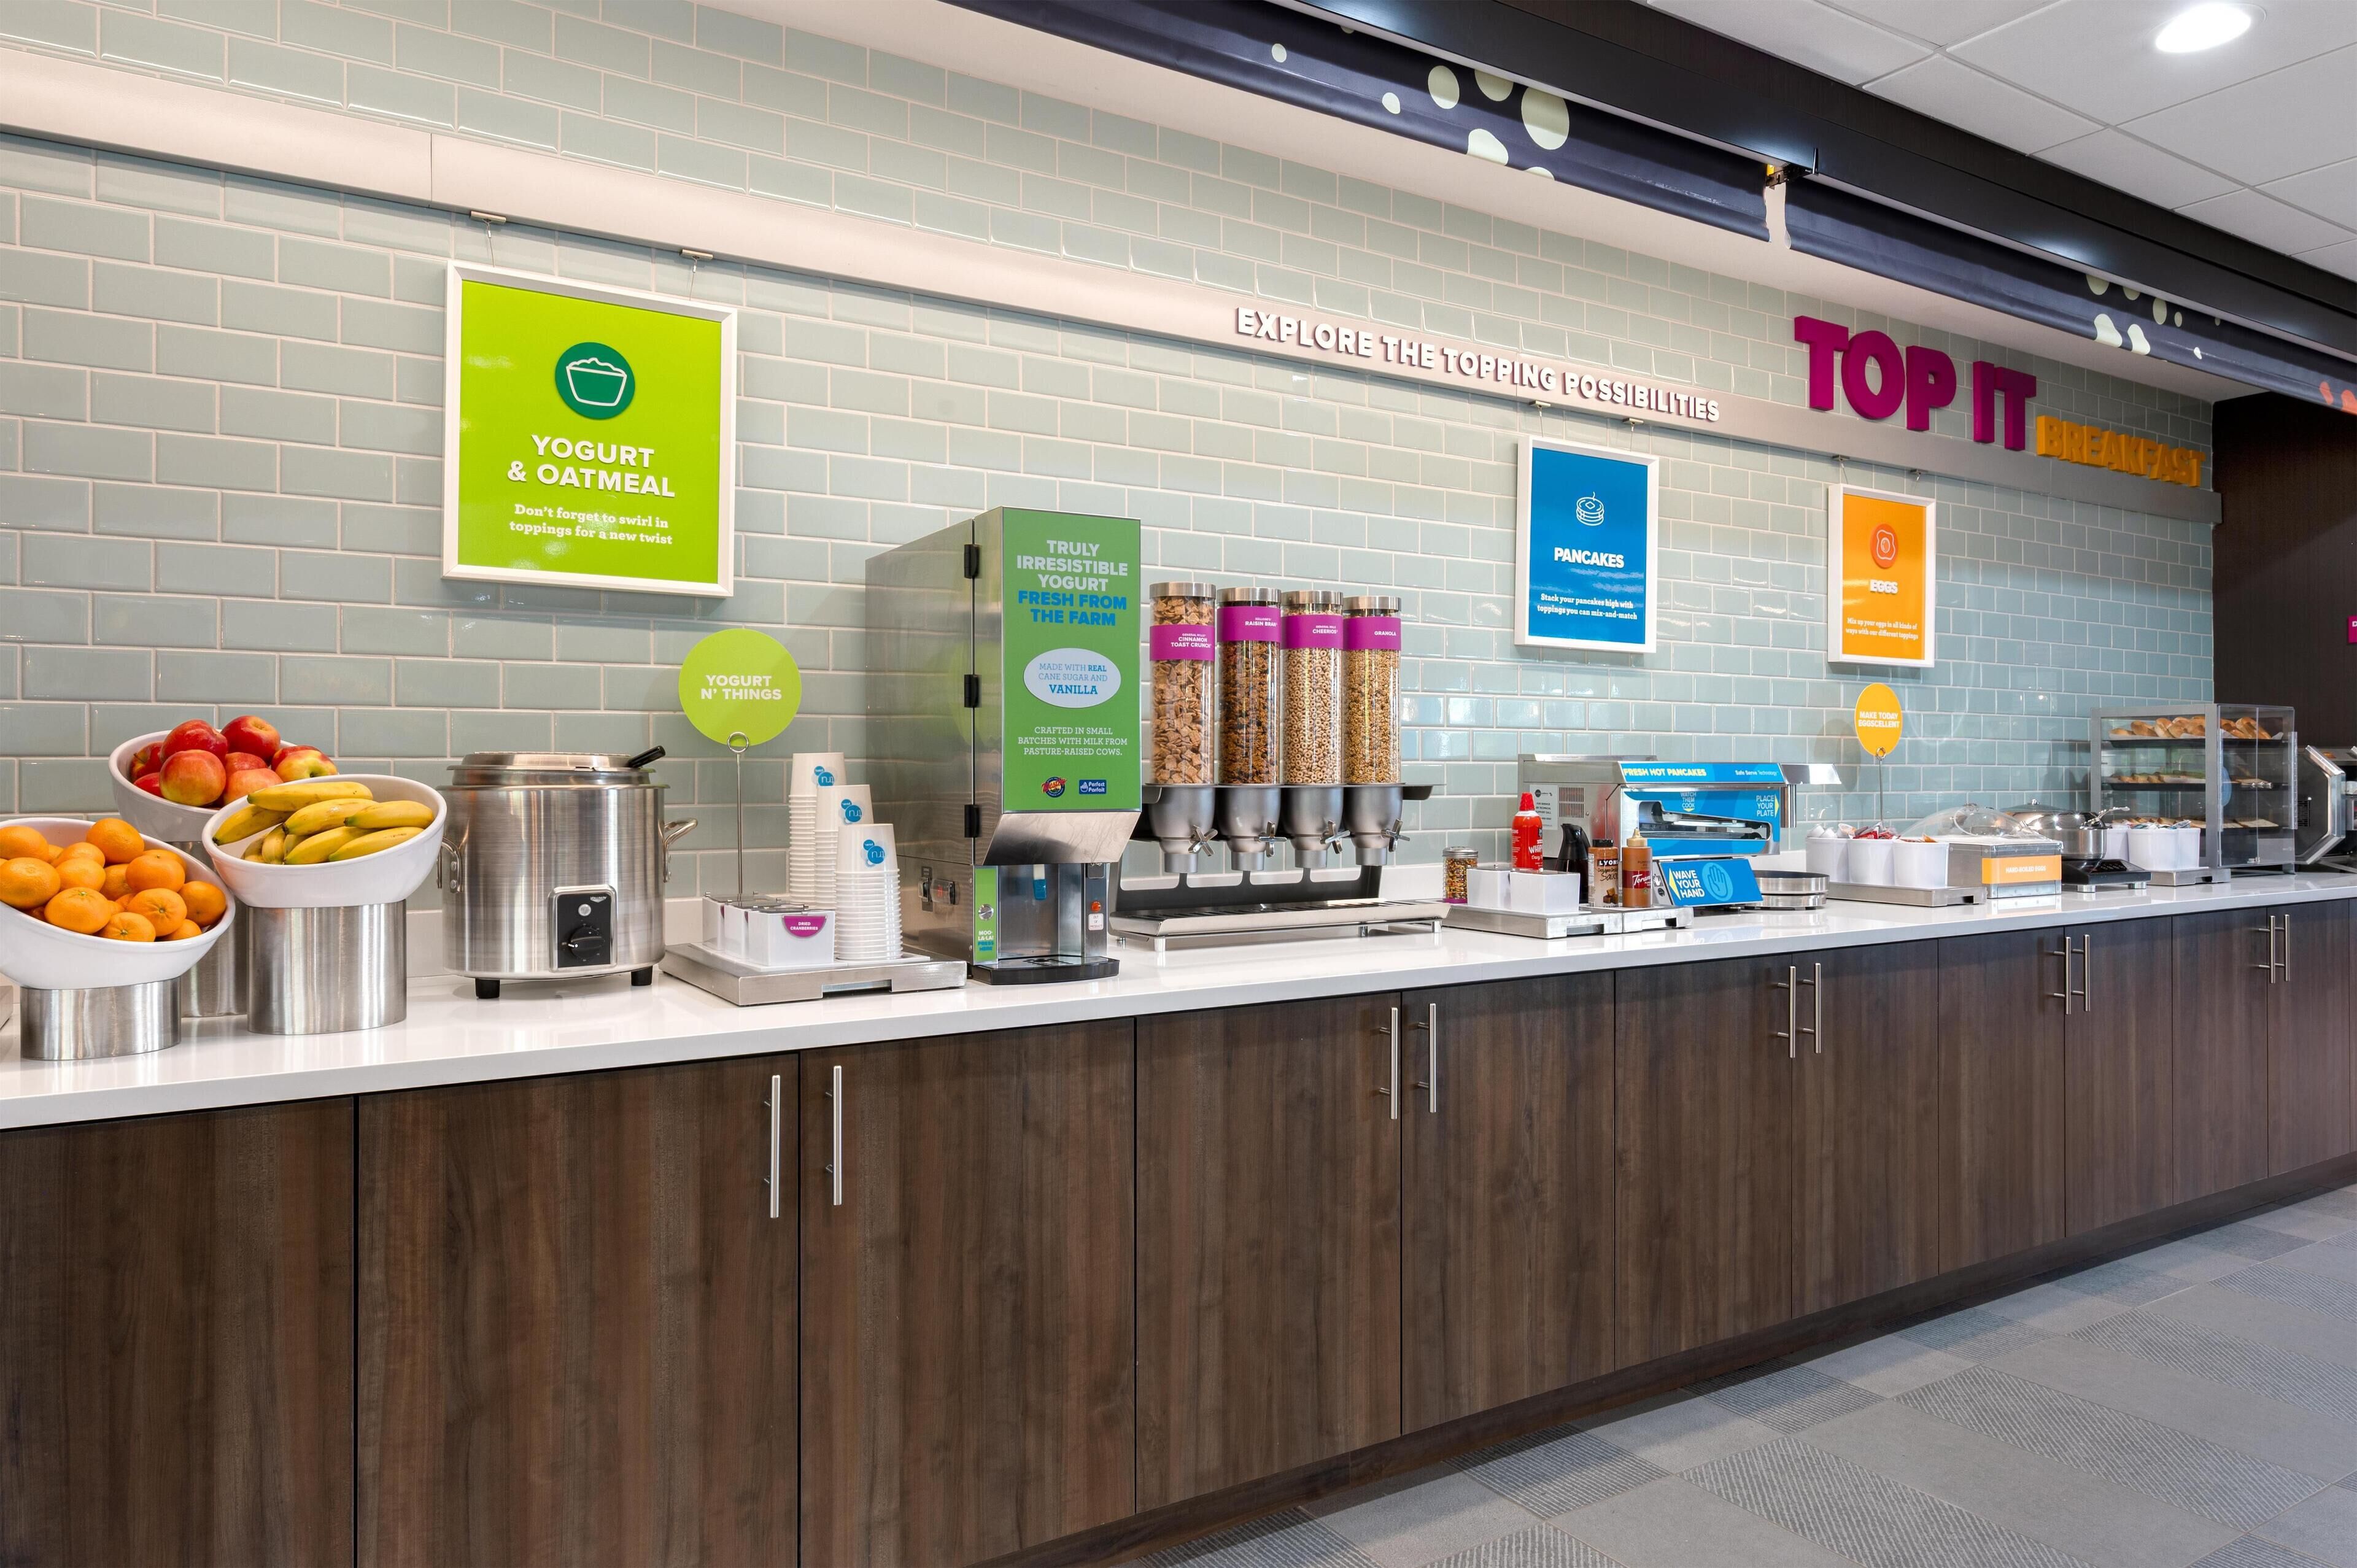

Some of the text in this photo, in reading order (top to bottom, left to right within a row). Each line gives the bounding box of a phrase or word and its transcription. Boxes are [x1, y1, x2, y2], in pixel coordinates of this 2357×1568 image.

[1236, 307, 1720, 422] EXPLORE THE TOPPING POSSIBILITIES
[1794, 315, 2037, 452] TOP IT
[531, 434, 654, 468] YOGURT
[2037, 415, 2205, 487] BREAKFAST
[507, 461, 675, 498] & OATMEAL
[514, 503, 668, 528] Don’t forget to swirl in
[509, 520, 673, 544] toppings for a new twist
[1047, 539, 1100, 557] TRULY
[1016, 555, 1128, 576] IRRESISTIBLE
[1554, 547, 1625, 568] PANCAKES
[1037, 574, 1109, 592] YOGURT
[1870, 579, 1898, 595] EGGS
[1018, 589, 1127, 610] FRESH FROM
[1541, 593, 1559, 602] Stack
[1560, 596, 1575, 604] your
[1575, 598, 1604, 606] pancakes
[1605, 599, 1619, 609] high
[1030, 608, 1116, 626] THE FARM
[1537, 604, 1566, 615] toppings
[1591, 609, 1638, 620] mix-and-match
[706, 674, 772, 687] YOGURT
[1049, 684, 1098, 695] VANILLA
[722, 689, 782, 700] THINGS
[1858, 719, 1900, 728] EGGSCELLENT
[1624, 768, 1648, 776] FRESH
[1673, 870, 1697, 879] WAVE
[1676, 879, 1701, 889] YOUR
[1681, 889, 1705, 898] HAND
